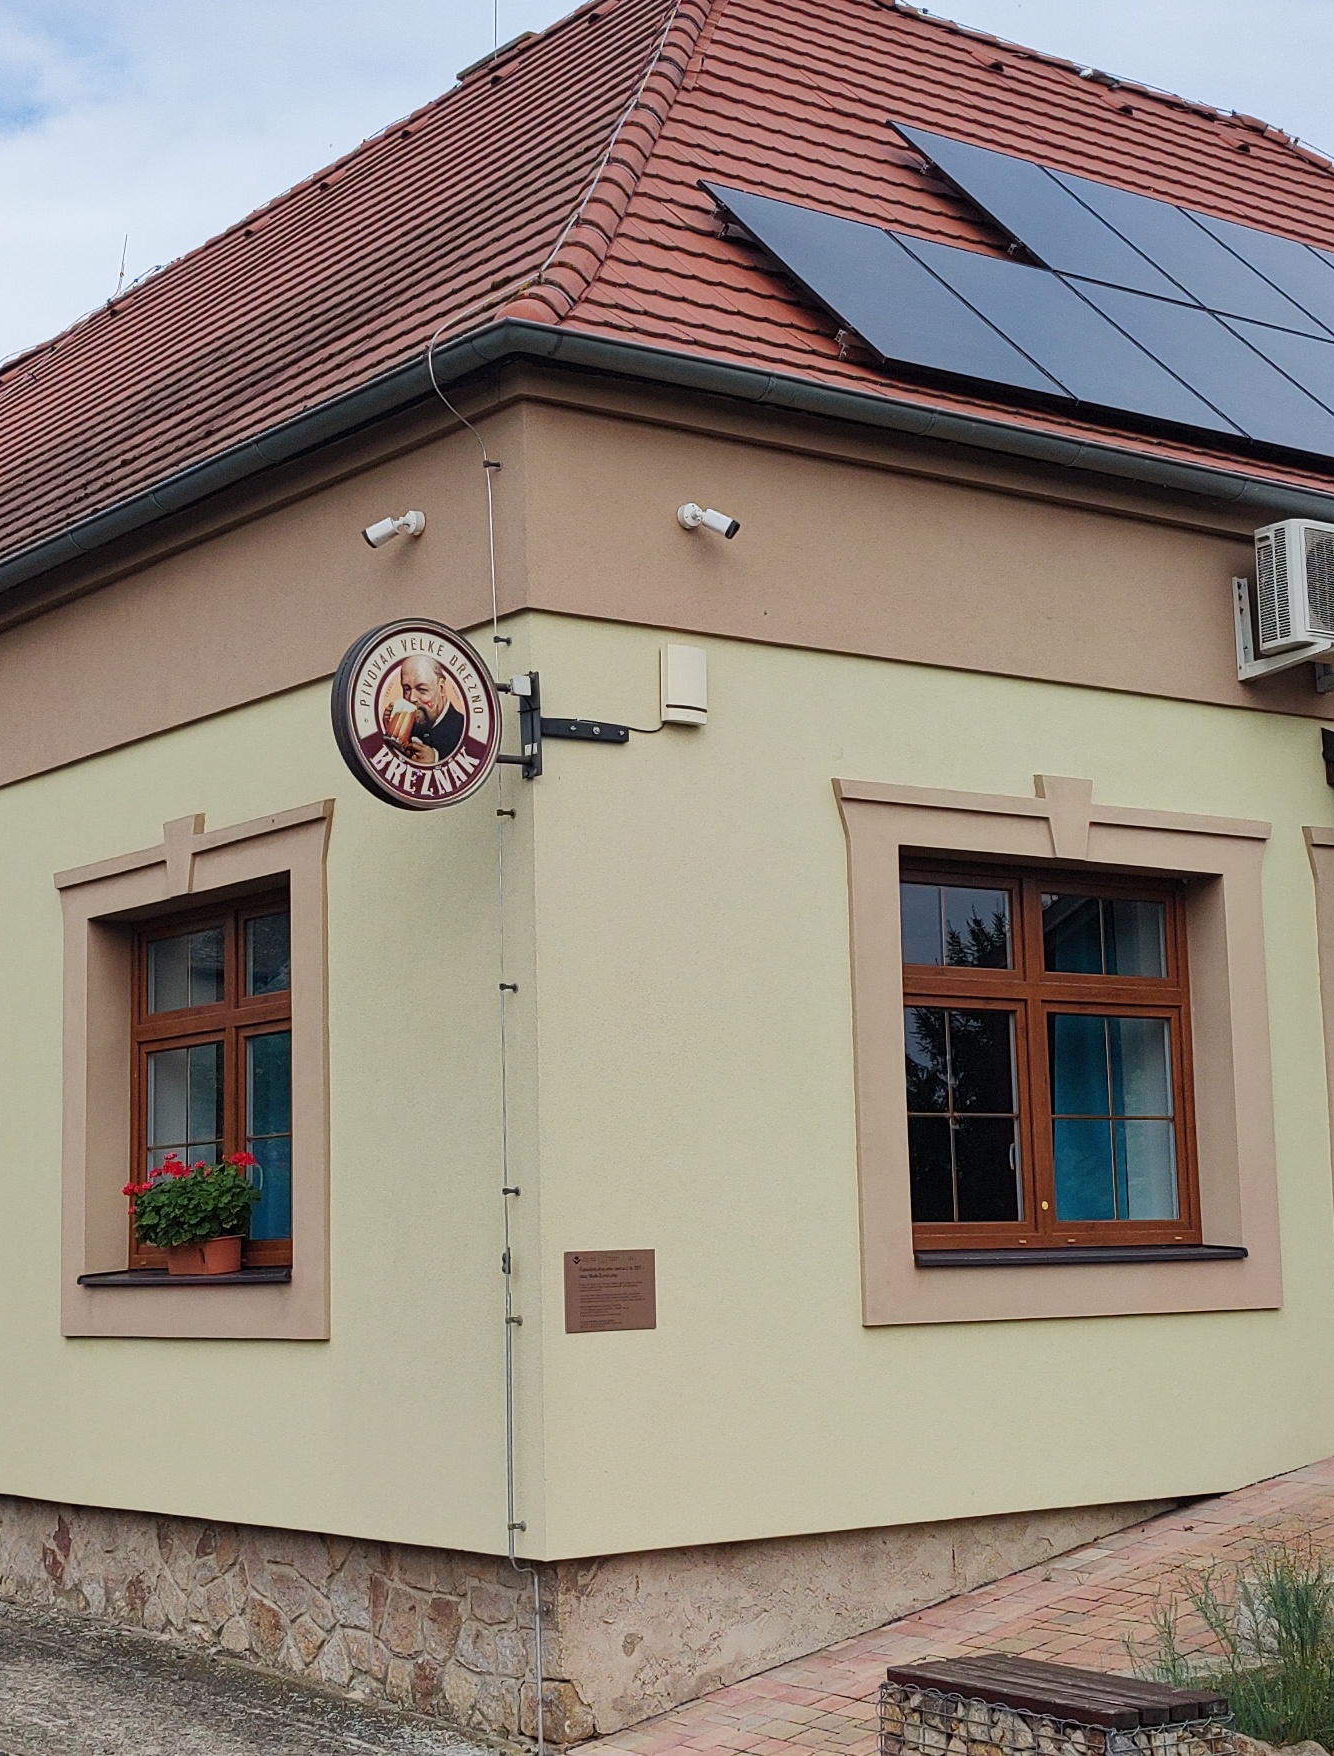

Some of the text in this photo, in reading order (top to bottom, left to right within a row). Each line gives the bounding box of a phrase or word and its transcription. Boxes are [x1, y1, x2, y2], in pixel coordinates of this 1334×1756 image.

[360, 645, 396, 708] PIVOVAR
[449, 655, 484, 714] BŘEZNO
[370, 744, 480, 796] BŘEZŇÁK
